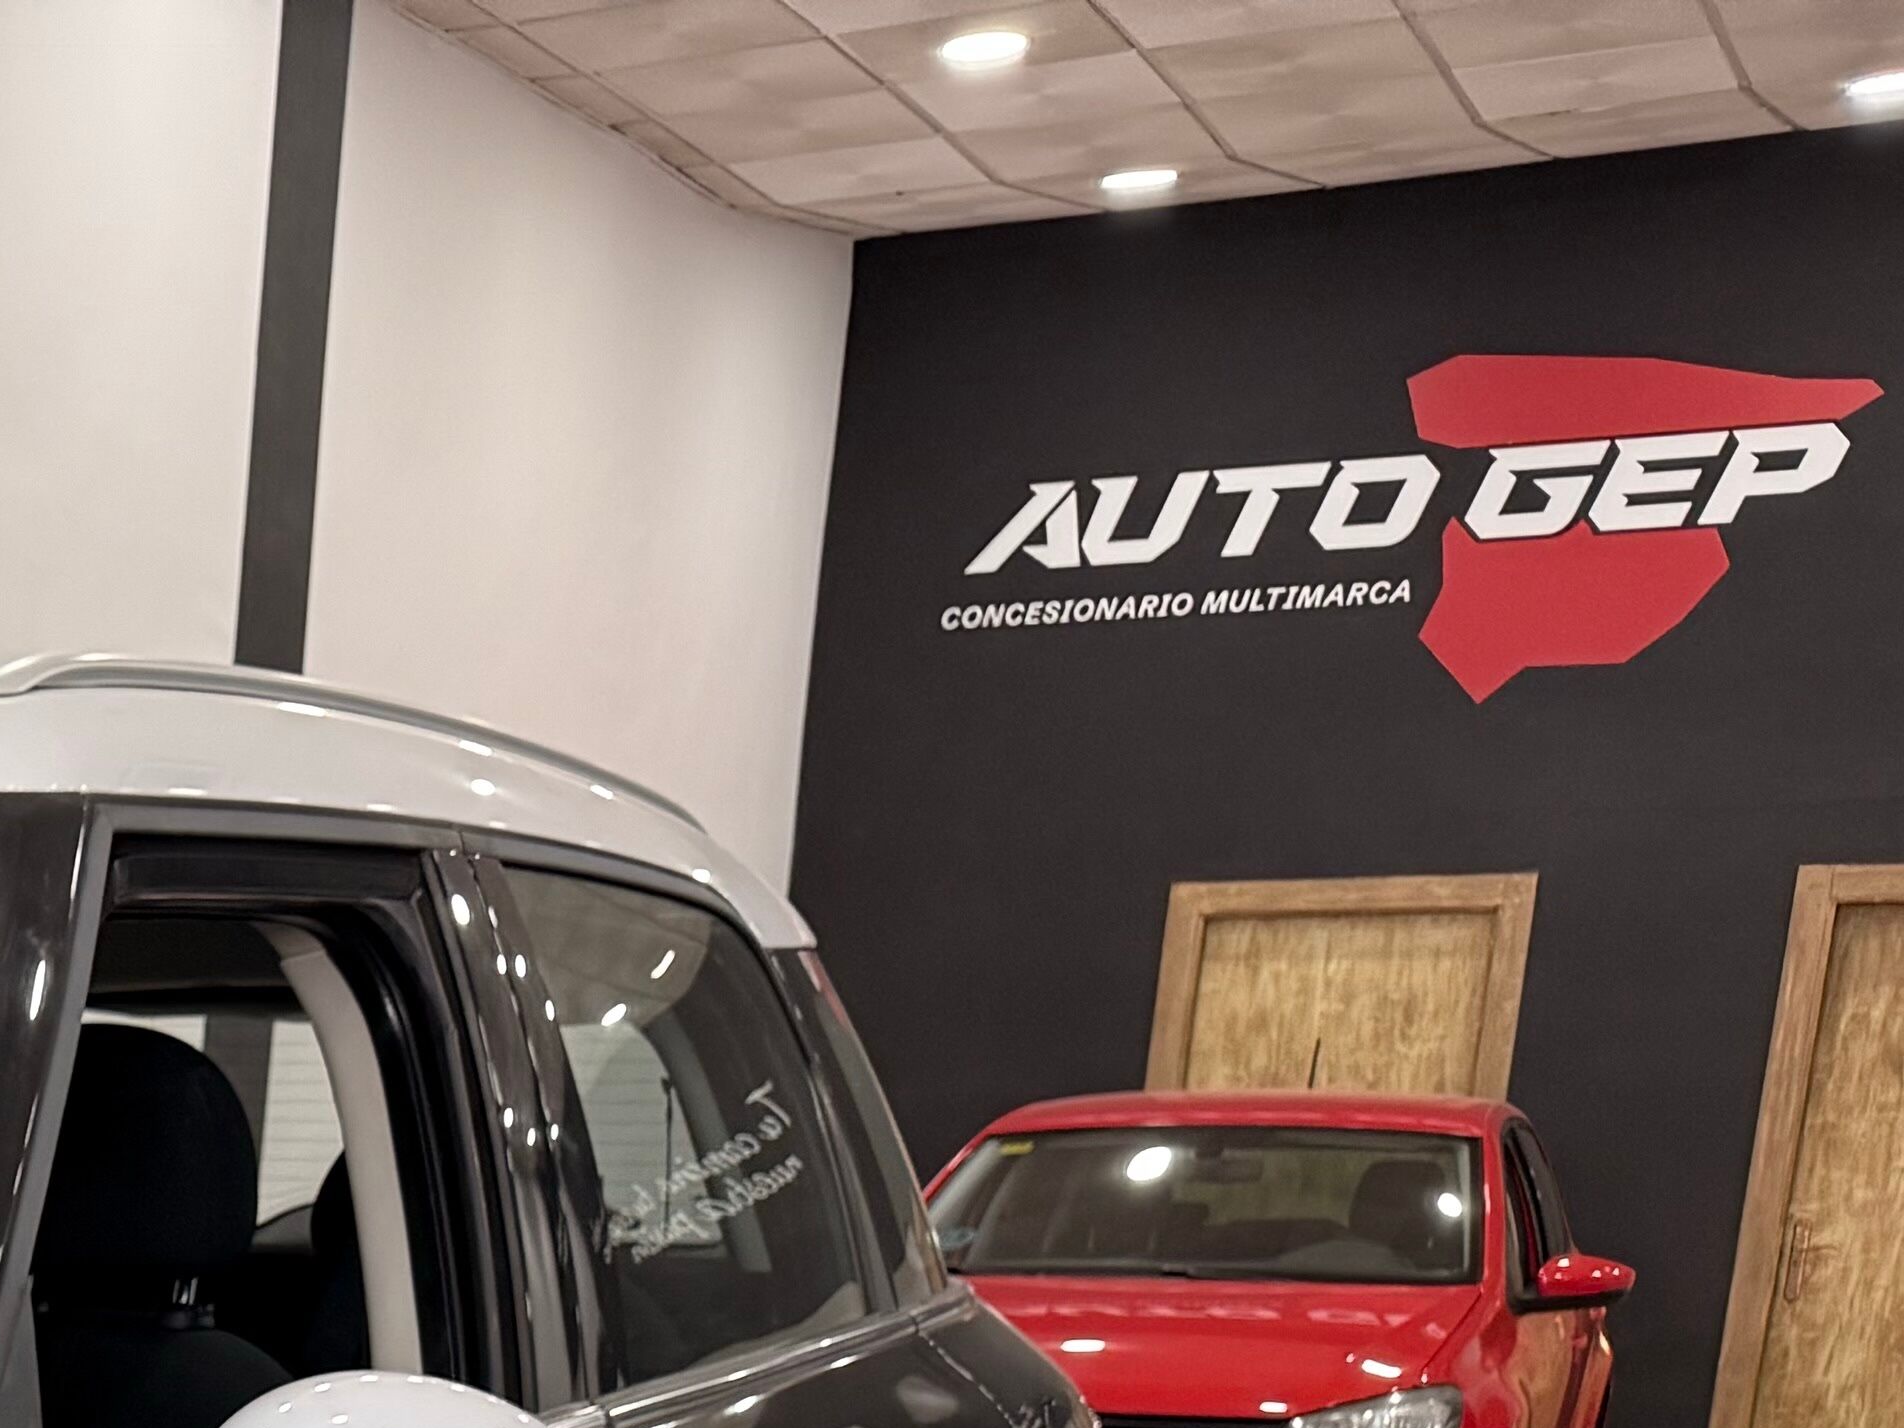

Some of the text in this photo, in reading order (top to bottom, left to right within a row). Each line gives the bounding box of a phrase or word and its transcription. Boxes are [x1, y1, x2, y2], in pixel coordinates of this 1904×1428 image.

[963, 422, 1851, 575] AUTO GEP
[940, 578, 1412, 631] CONCESIONARIO MULTIMARCA
